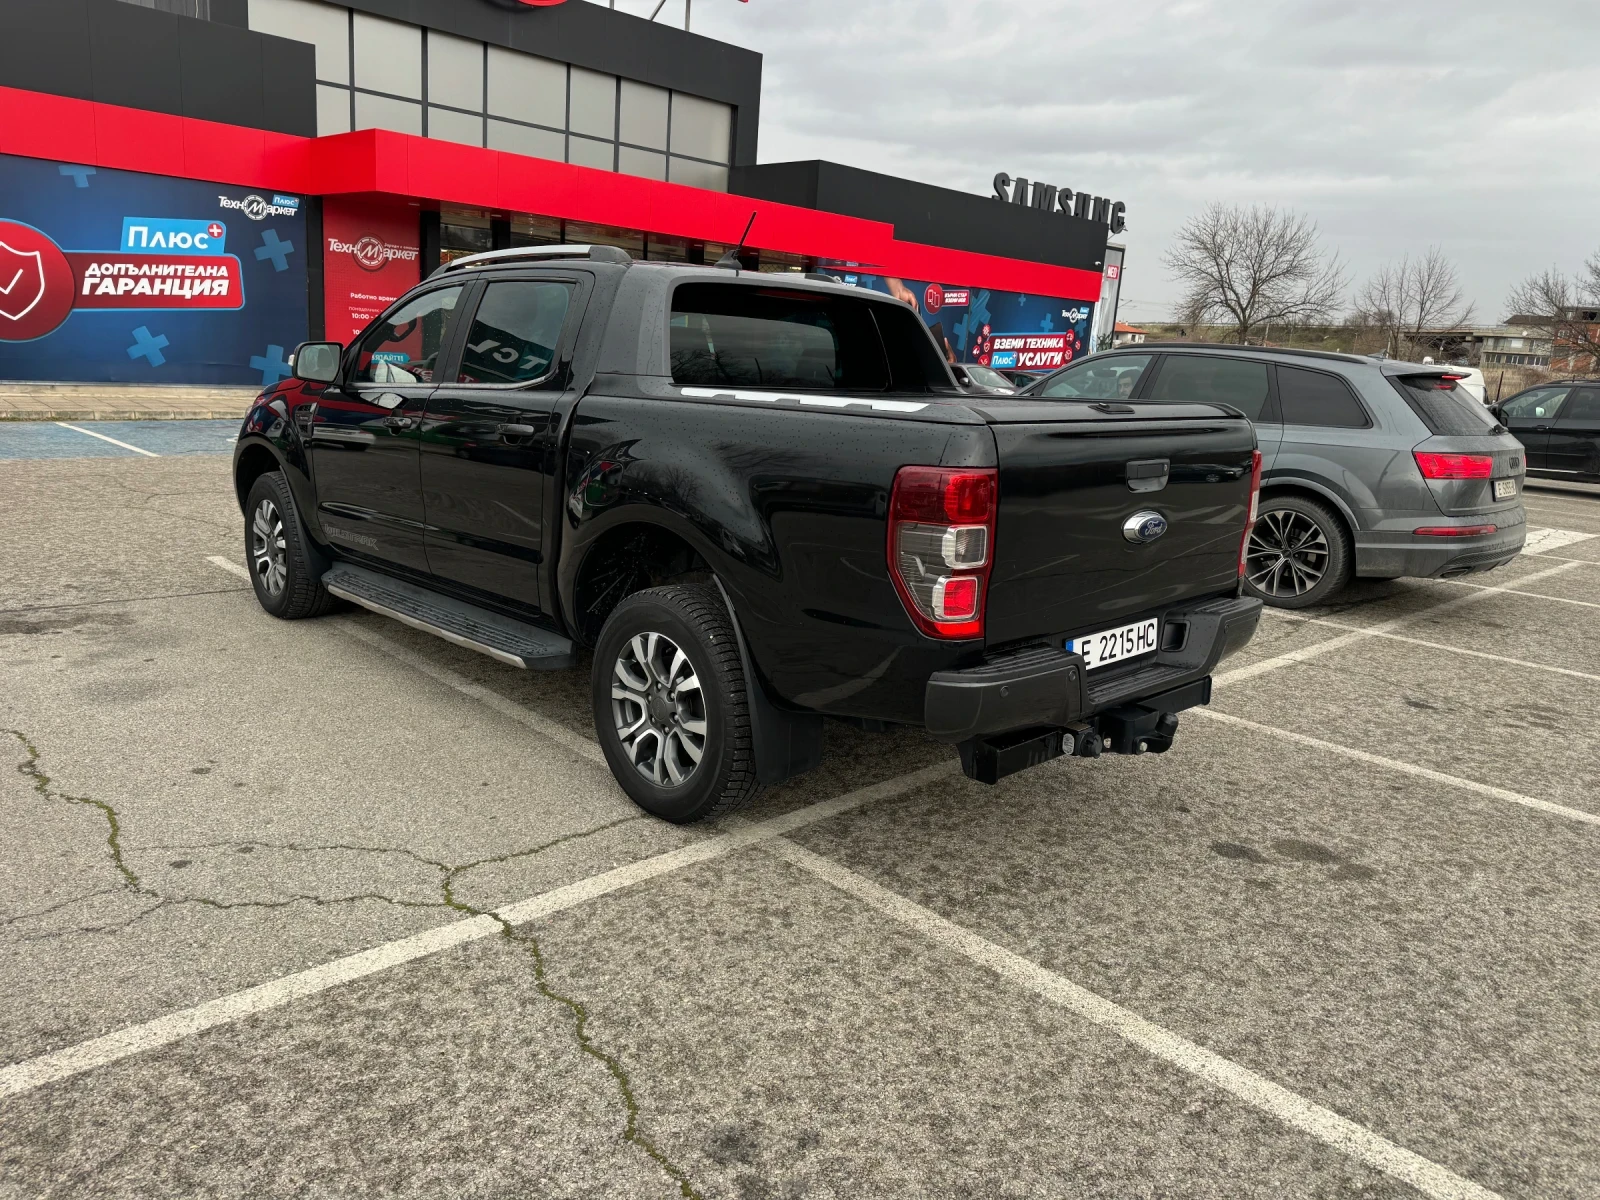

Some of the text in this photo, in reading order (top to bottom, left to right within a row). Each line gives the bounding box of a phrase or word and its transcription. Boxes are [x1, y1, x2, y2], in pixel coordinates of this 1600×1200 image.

[992, 172, 1126, 234] SAMSUNG
[84, 263, 228, 278] ДОПЪЛНИТЕЛНА
[82, 277, 230, 300] ГАРАНЦИЯ
[350, 292, 377, 300] Работно
[993, 337, 1064, 349] ВЗЕМИ ТЕХНИКА
[1018, 351, 1063, 367] УСЛУГИ
[1145, 520, 1163, 536] Ford
[1081, 640, 1091, 666] E
